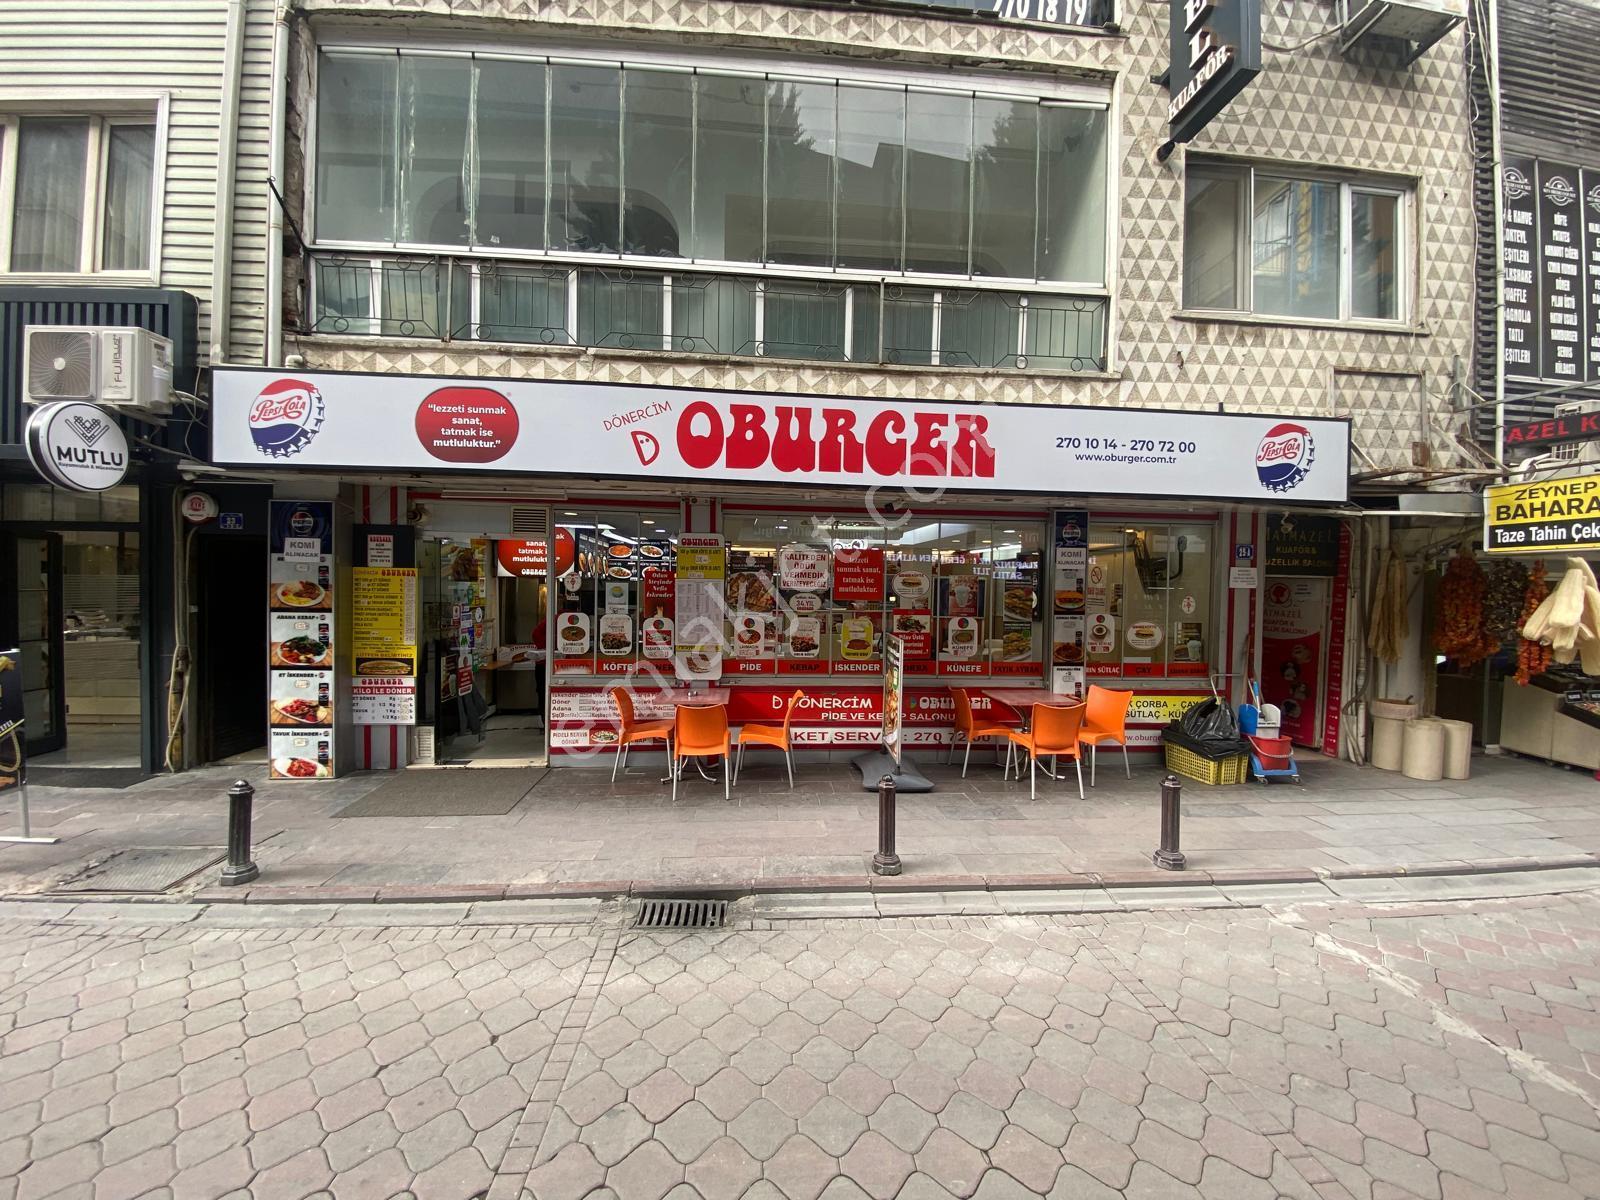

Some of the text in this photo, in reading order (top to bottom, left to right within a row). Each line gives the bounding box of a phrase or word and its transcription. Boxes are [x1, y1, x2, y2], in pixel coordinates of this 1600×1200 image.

[1504, 228, 1527, 244] OKTEYL
[1505, 308, 1532, 324] AGNOLIA
[1508, 328, 1524, 342] TATLI
[1505, 348, 1530, 364] EŞİTLERİ
[467, 405, 506, 415] sunmak
[452, 416, 483, 426] sanat,
[603, 400, 672, 432] DÖNERCİM
[441, 428, 494, 437] tatmak ise
[676, 400, 996, 479] OBURGER
[1056, 437, 1081, 449] 270
[1085, 438, 1100, 450] 10
[1103, 438, 1118, 450] 14
[1130, 440, 1154, 452] 270
[1158, 440, 1175, 453] 72
[1178, 442, 1196, 454] 00
[56, 445, 124, 466] MUTLU
[1075, 453, 1177, 465] www.oburger.com.tr
[1514, 482, 1598, 501] ZEYNEP
[1495, 529, 1526, 543] Taze
[1529, 526, 1566, 542] Tahin
[290, 541, 315, 549] KOMİ
[681, 538, 720, 546] OBURGER
[1061, 550, 1082, 558] KOMİ
[602, 662, 632, 670] KÖFTE
[834, 662, 880, 672] İSKENDER
[946, 662, 982, 672] KÜNEFE
[1098, 666, 1120, 674] SÜTLAÇ
[1136, 700, 1168, 710] ÇORBA
[1180, 700, 1198, 710] ÇAY
[822, 710, 847, 720] PİDE
[850, 712, 864, 720] VE
[910, 712, 956, 720] SALONU
[1125, 708, 1160, 719] SÜTLAÇ
[790, 732, 828, 741] KET
[914, 732, 942, 742] 270
